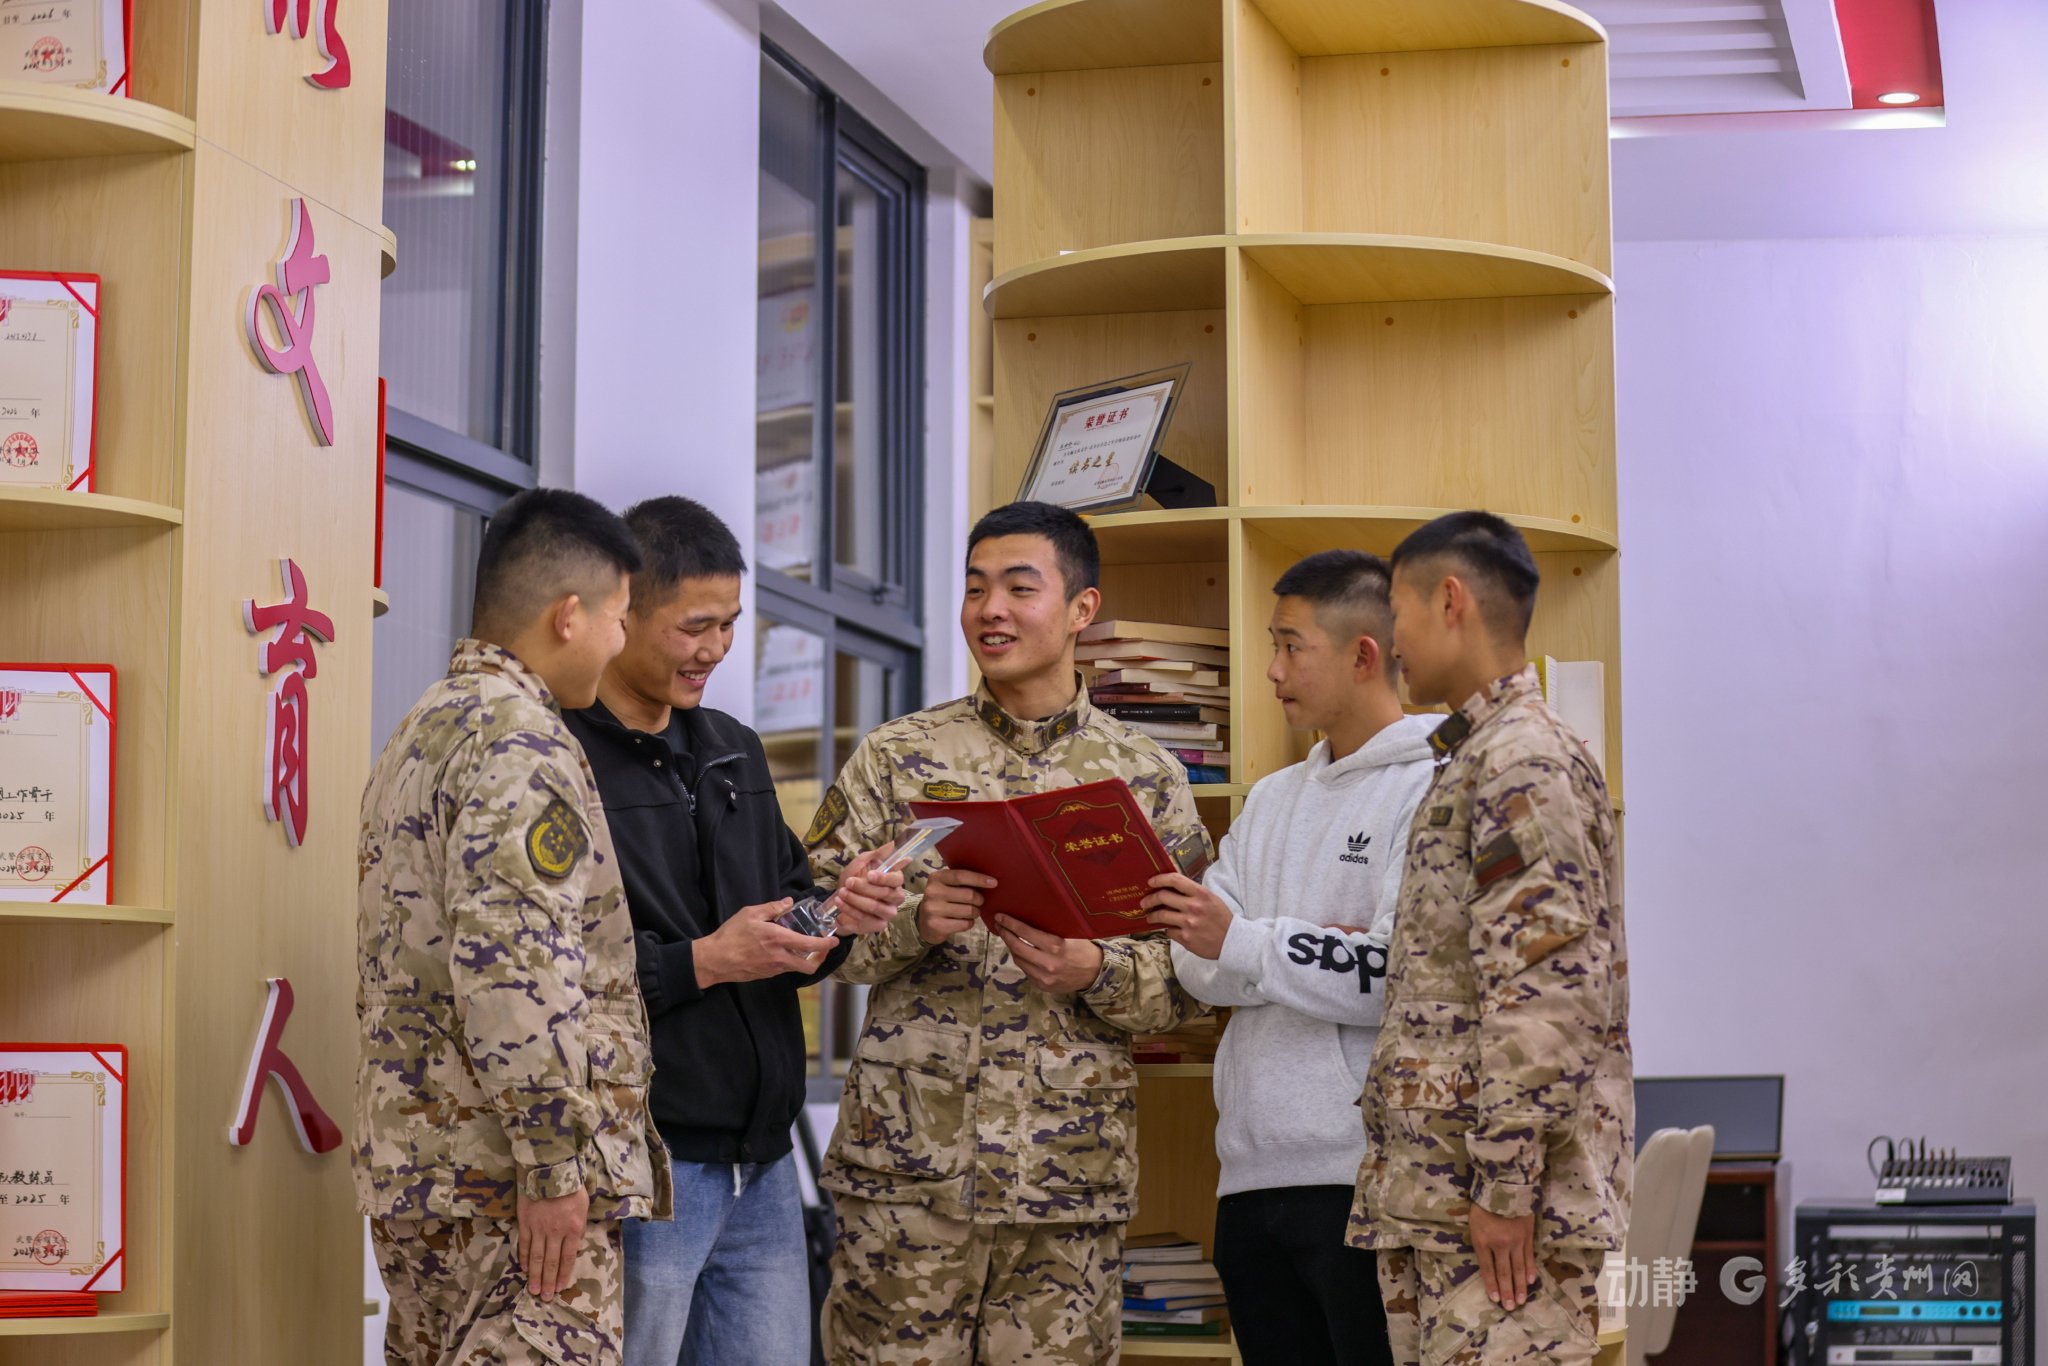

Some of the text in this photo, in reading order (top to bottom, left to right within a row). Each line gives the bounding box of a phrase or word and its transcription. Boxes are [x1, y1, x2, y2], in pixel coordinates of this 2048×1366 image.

[45, 811, 56, 822] 年
[1064, 833, 1124, 853] 荣誉证书
[1339, 852, 1369, 865] adidas
[16, 1193, 46, 1204] 2025
[60, 1194, 70, 1206] 年
